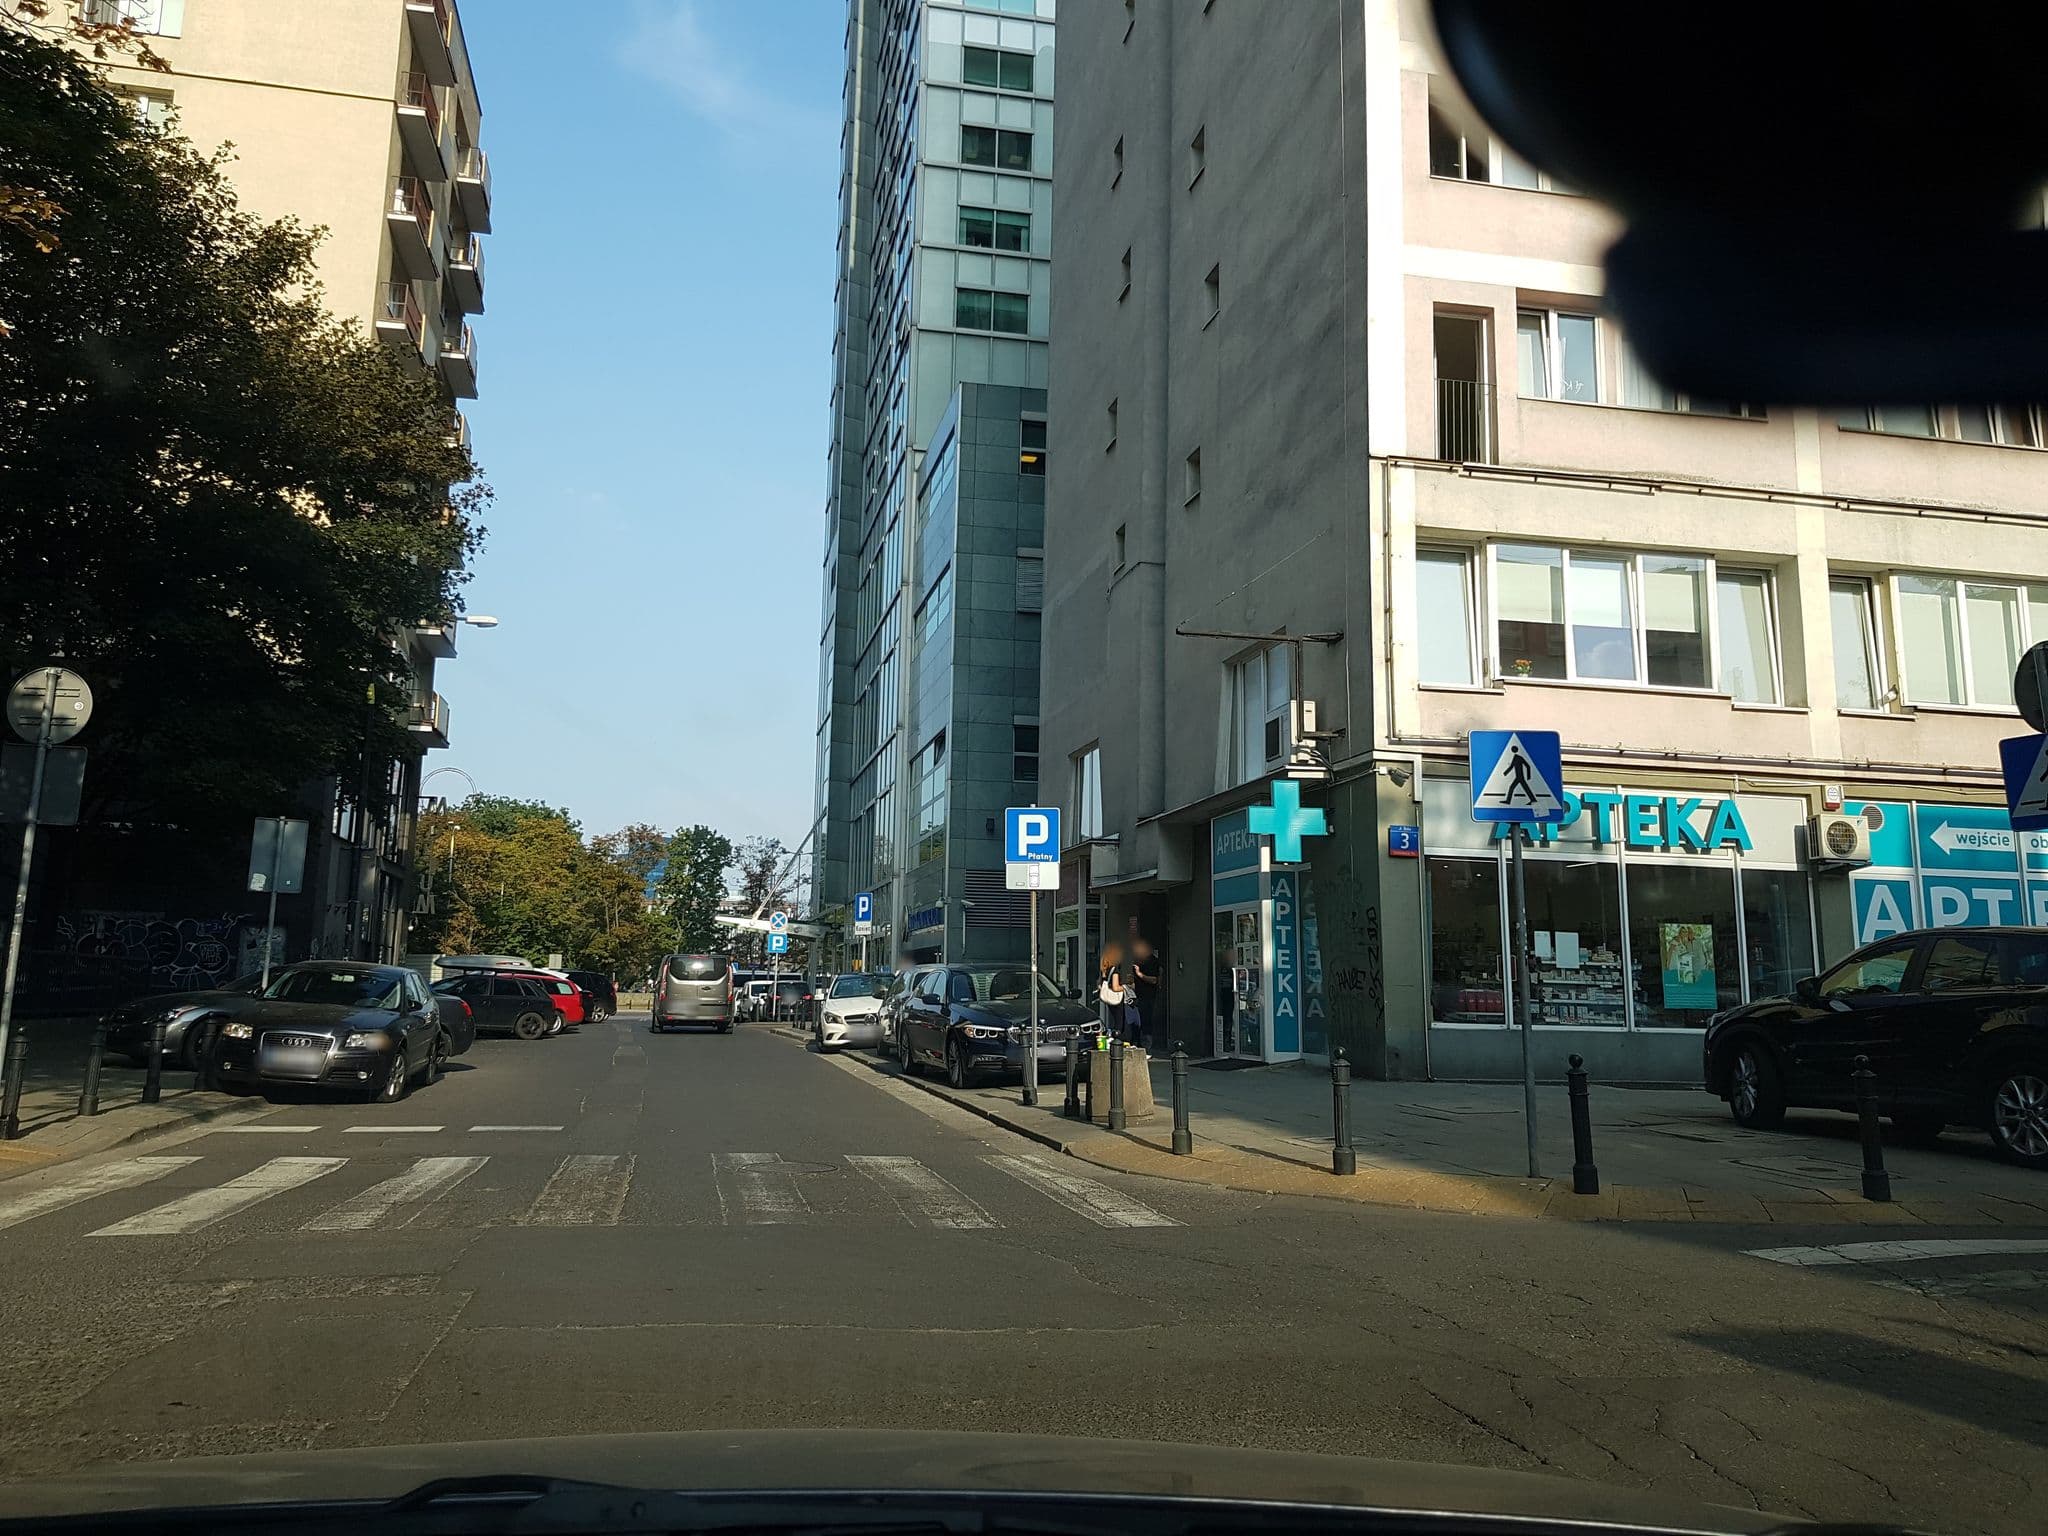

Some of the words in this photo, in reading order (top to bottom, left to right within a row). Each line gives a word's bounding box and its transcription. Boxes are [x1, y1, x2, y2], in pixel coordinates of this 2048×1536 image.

[1018, 814, 1049, 857] P
[1217, 828, 1257, 857] APTEKA
[1400, 832, 1410, 850] 3
[1955, 831, 2011, 848] wejście
[1027, 852, 1054, 861] Płatny
[858, 896, 869, 919] P
[771, 935, 784, 951] P
[1274, 877, 1295, 1018] APTEKA
